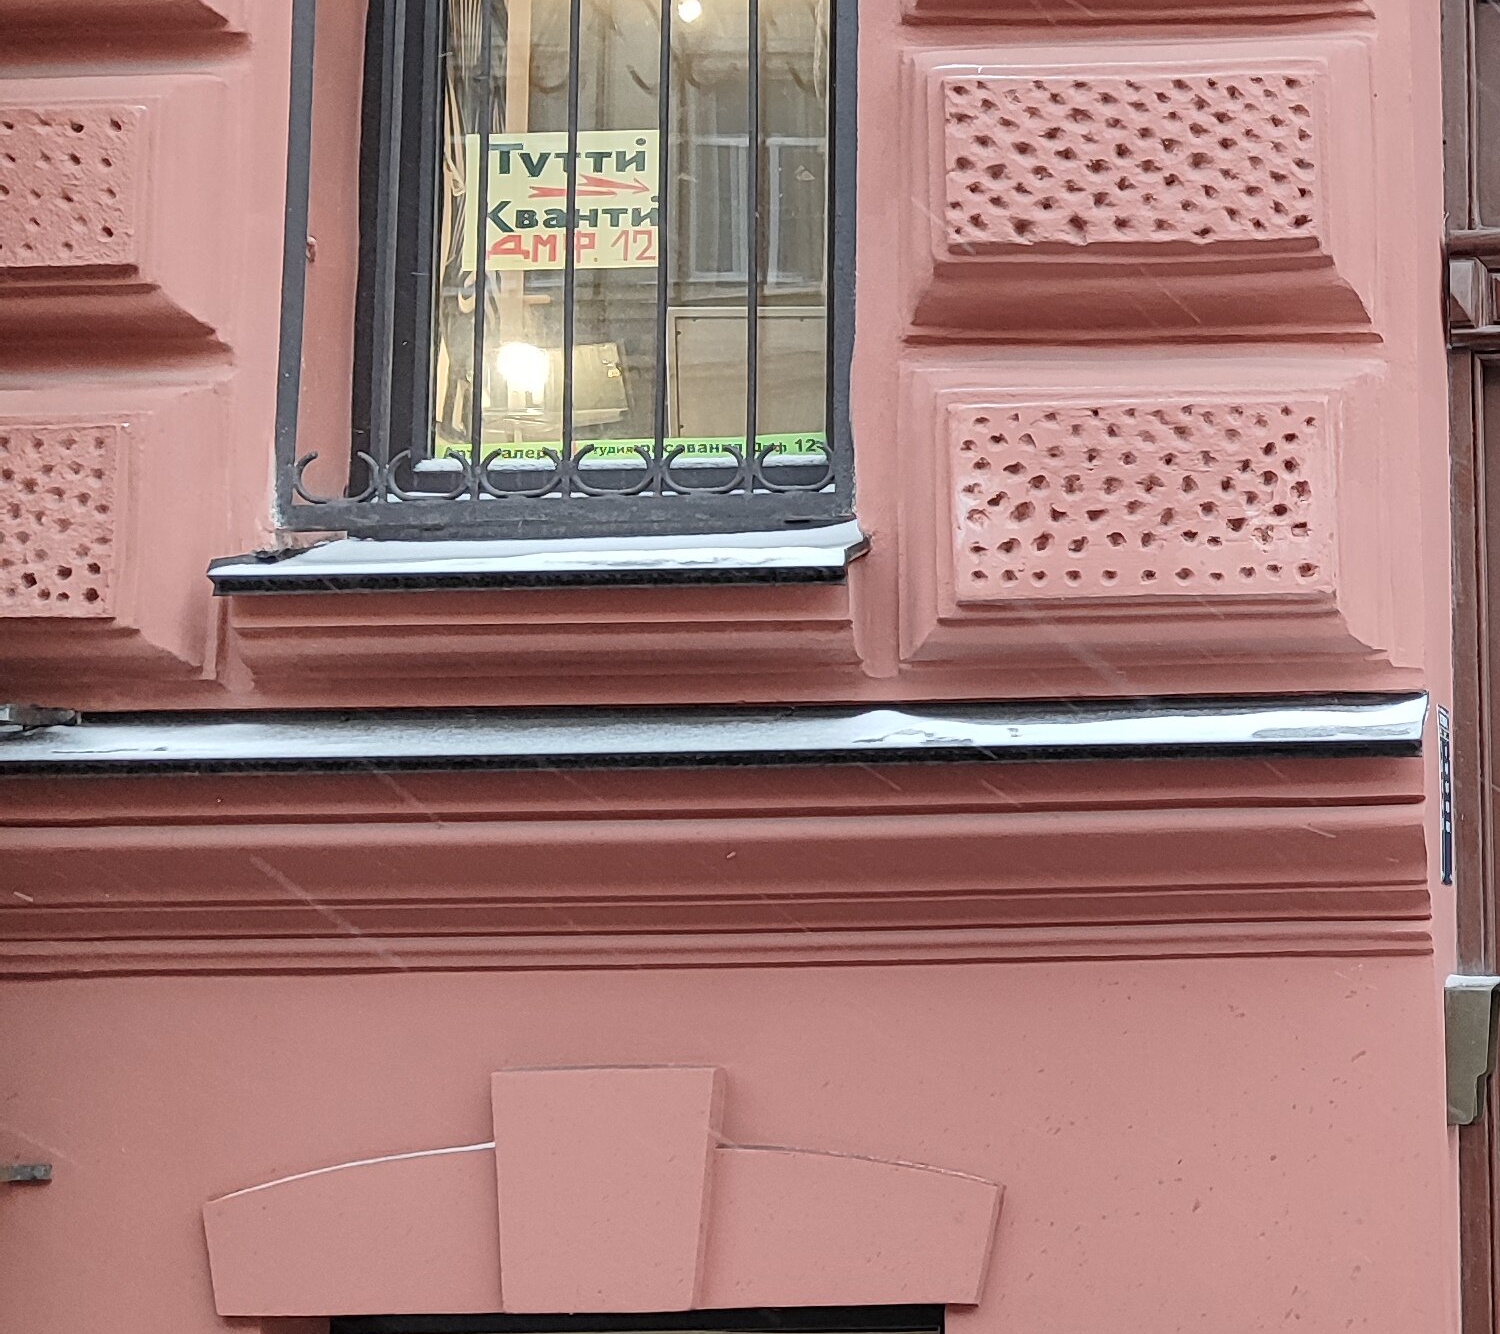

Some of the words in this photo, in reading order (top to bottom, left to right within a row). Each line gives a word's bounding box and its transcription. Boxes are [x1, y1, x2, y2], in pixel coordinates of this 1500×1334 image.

[611, 229, 657, 261] 12
[588, 445, 633, 456] тудия
[633, 442, 743, 455] рсвания
[794, 438, 817, 452] 12
